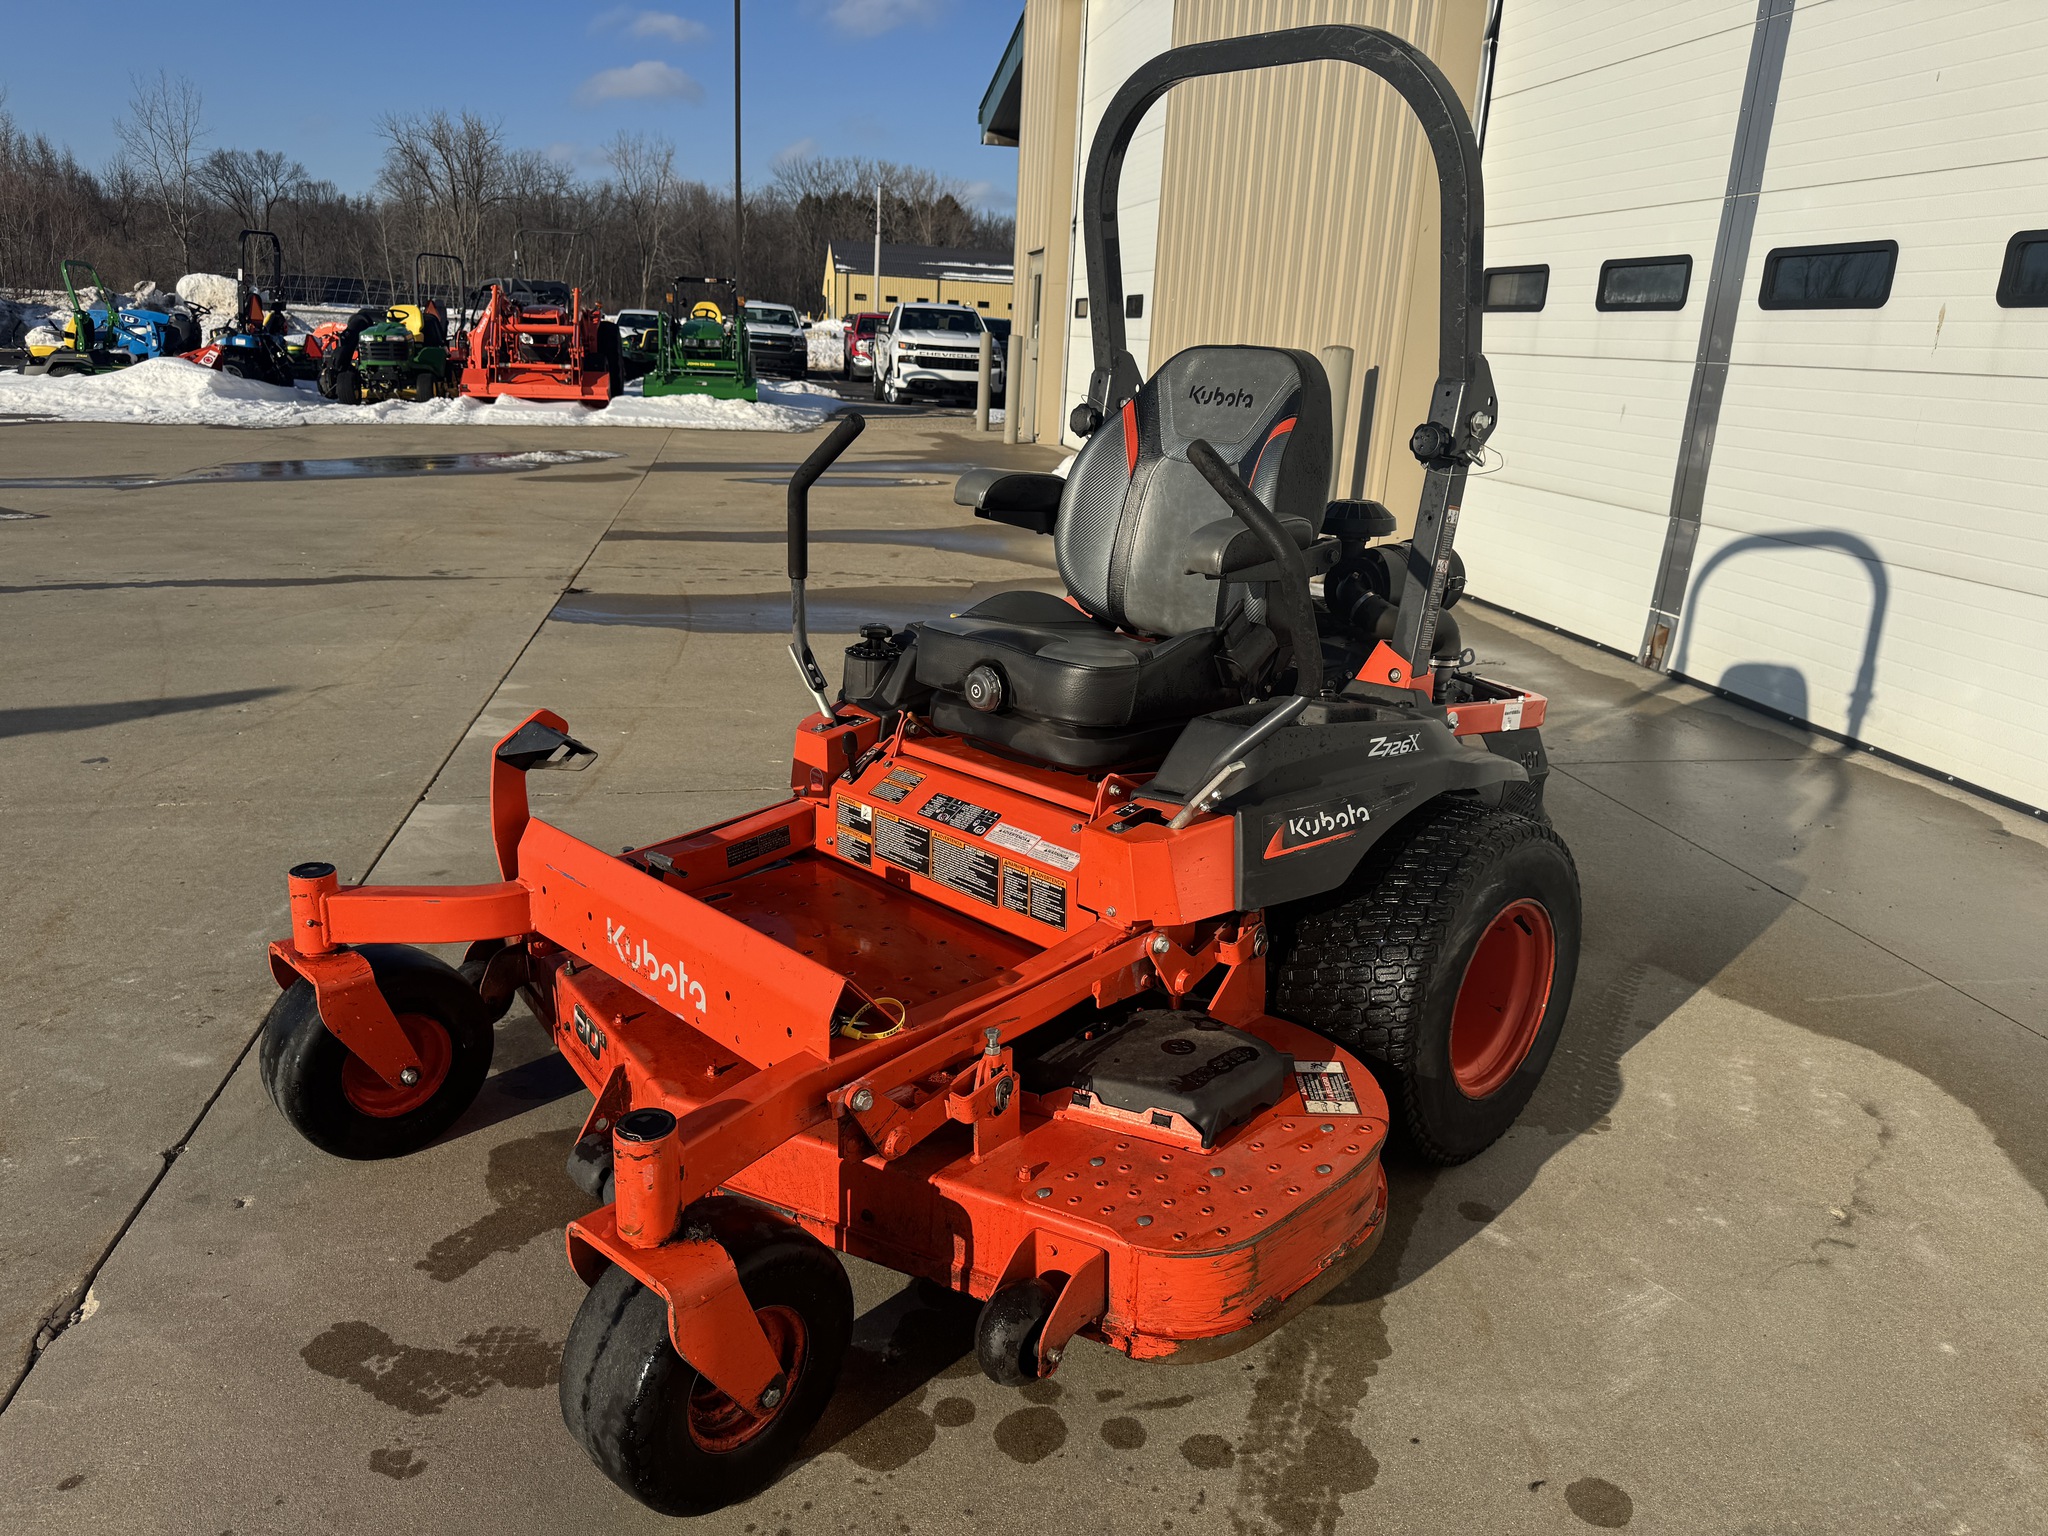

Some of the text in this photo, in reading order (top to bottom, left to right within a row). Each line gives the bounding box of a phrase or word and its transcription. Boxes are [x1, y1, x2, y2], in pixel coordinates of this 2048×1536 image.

[1189, 385, 1253, 408] Kubota
[1368, 734, 1421, 757] Z726X
[1289, 804, 1370, 837] Kubota
[606, 917, 706, 1014] Kubota
